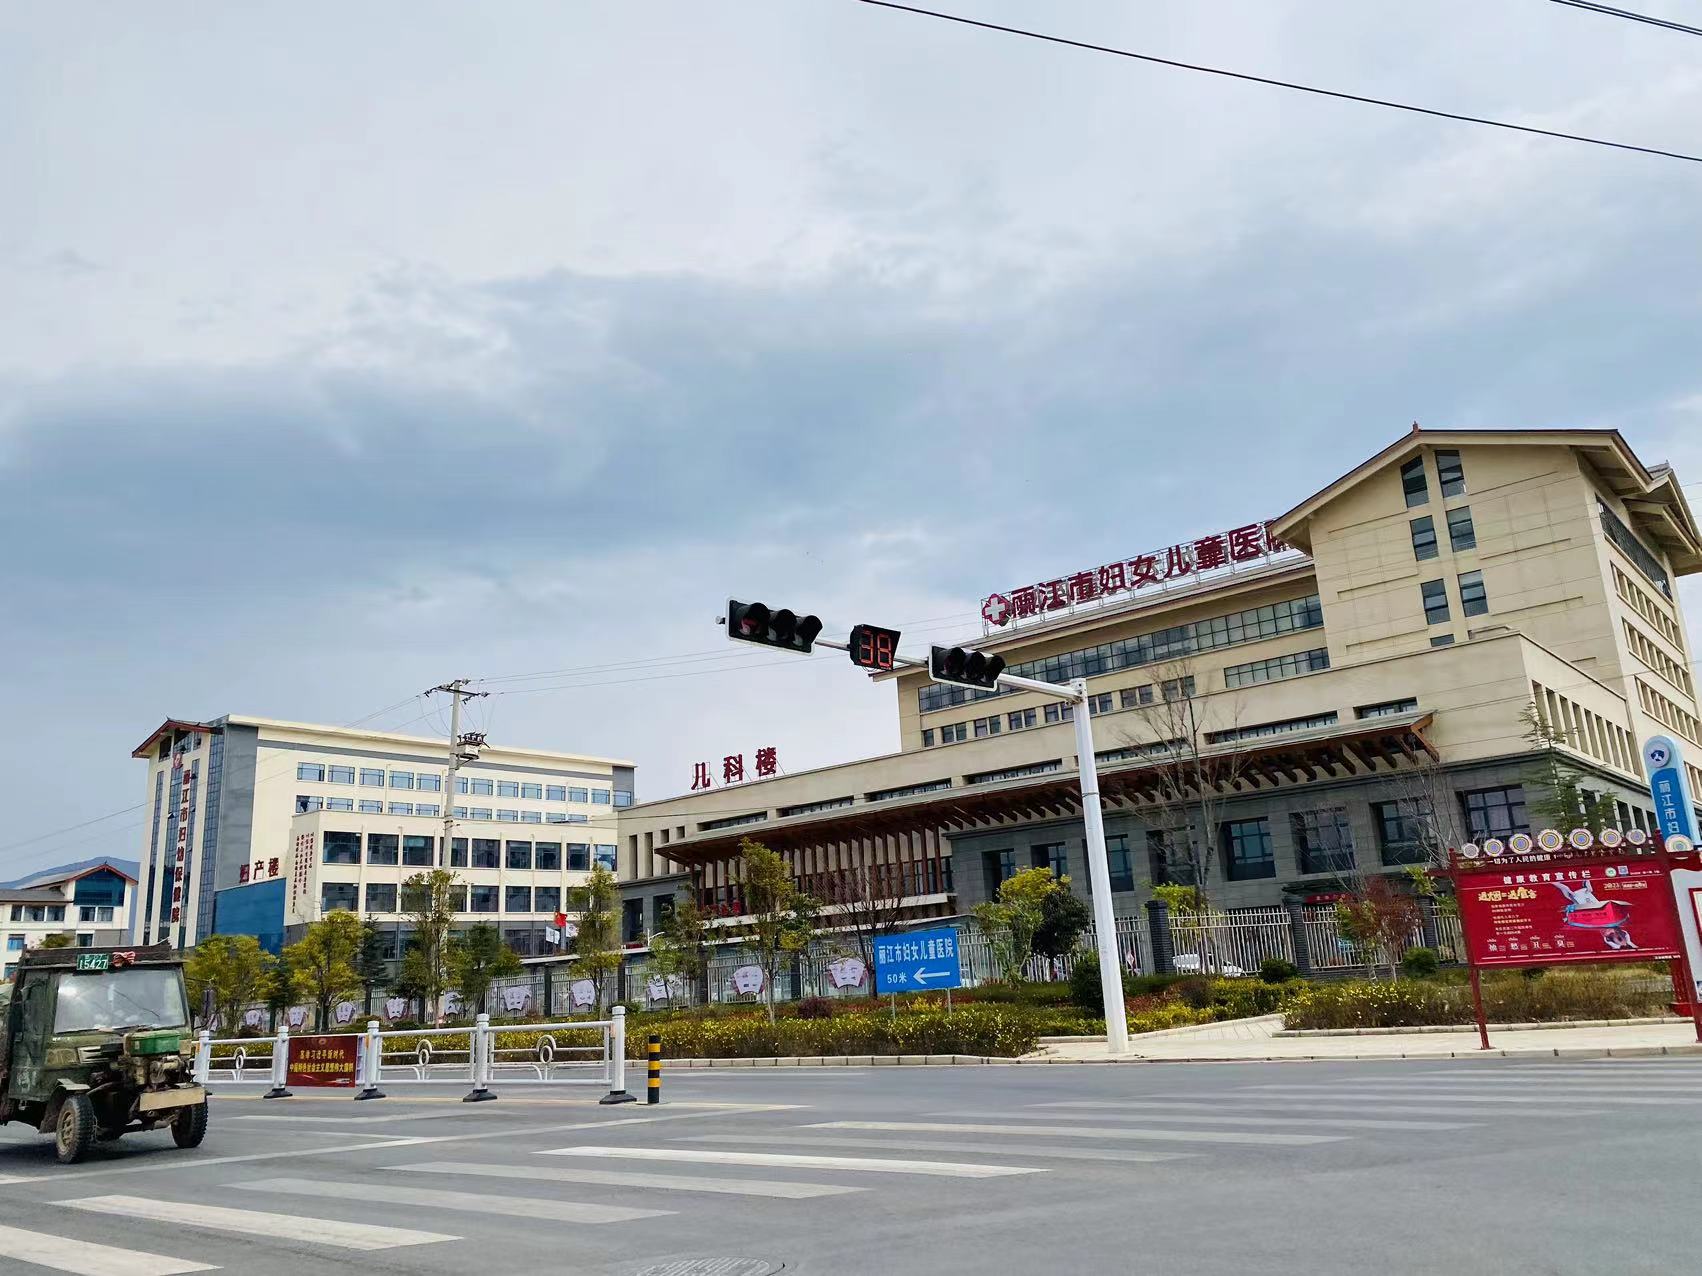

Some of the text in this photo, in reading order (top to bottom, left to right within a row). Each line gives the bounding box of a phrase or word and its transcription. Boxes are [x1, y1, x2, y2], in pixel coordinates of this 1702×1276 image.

[690, 746, 777, 790] 儿科楼
[171, 769, 191, 924] 丽江市妇幼保健院
[239, 857, 280, 883] 妇产楼
[1503, 869, 1592, 886] 健康教育宣传栏
[878, 937, 954, 965] 丽江市妇女儿童医院
[886, 972, 907, 984] 50米
